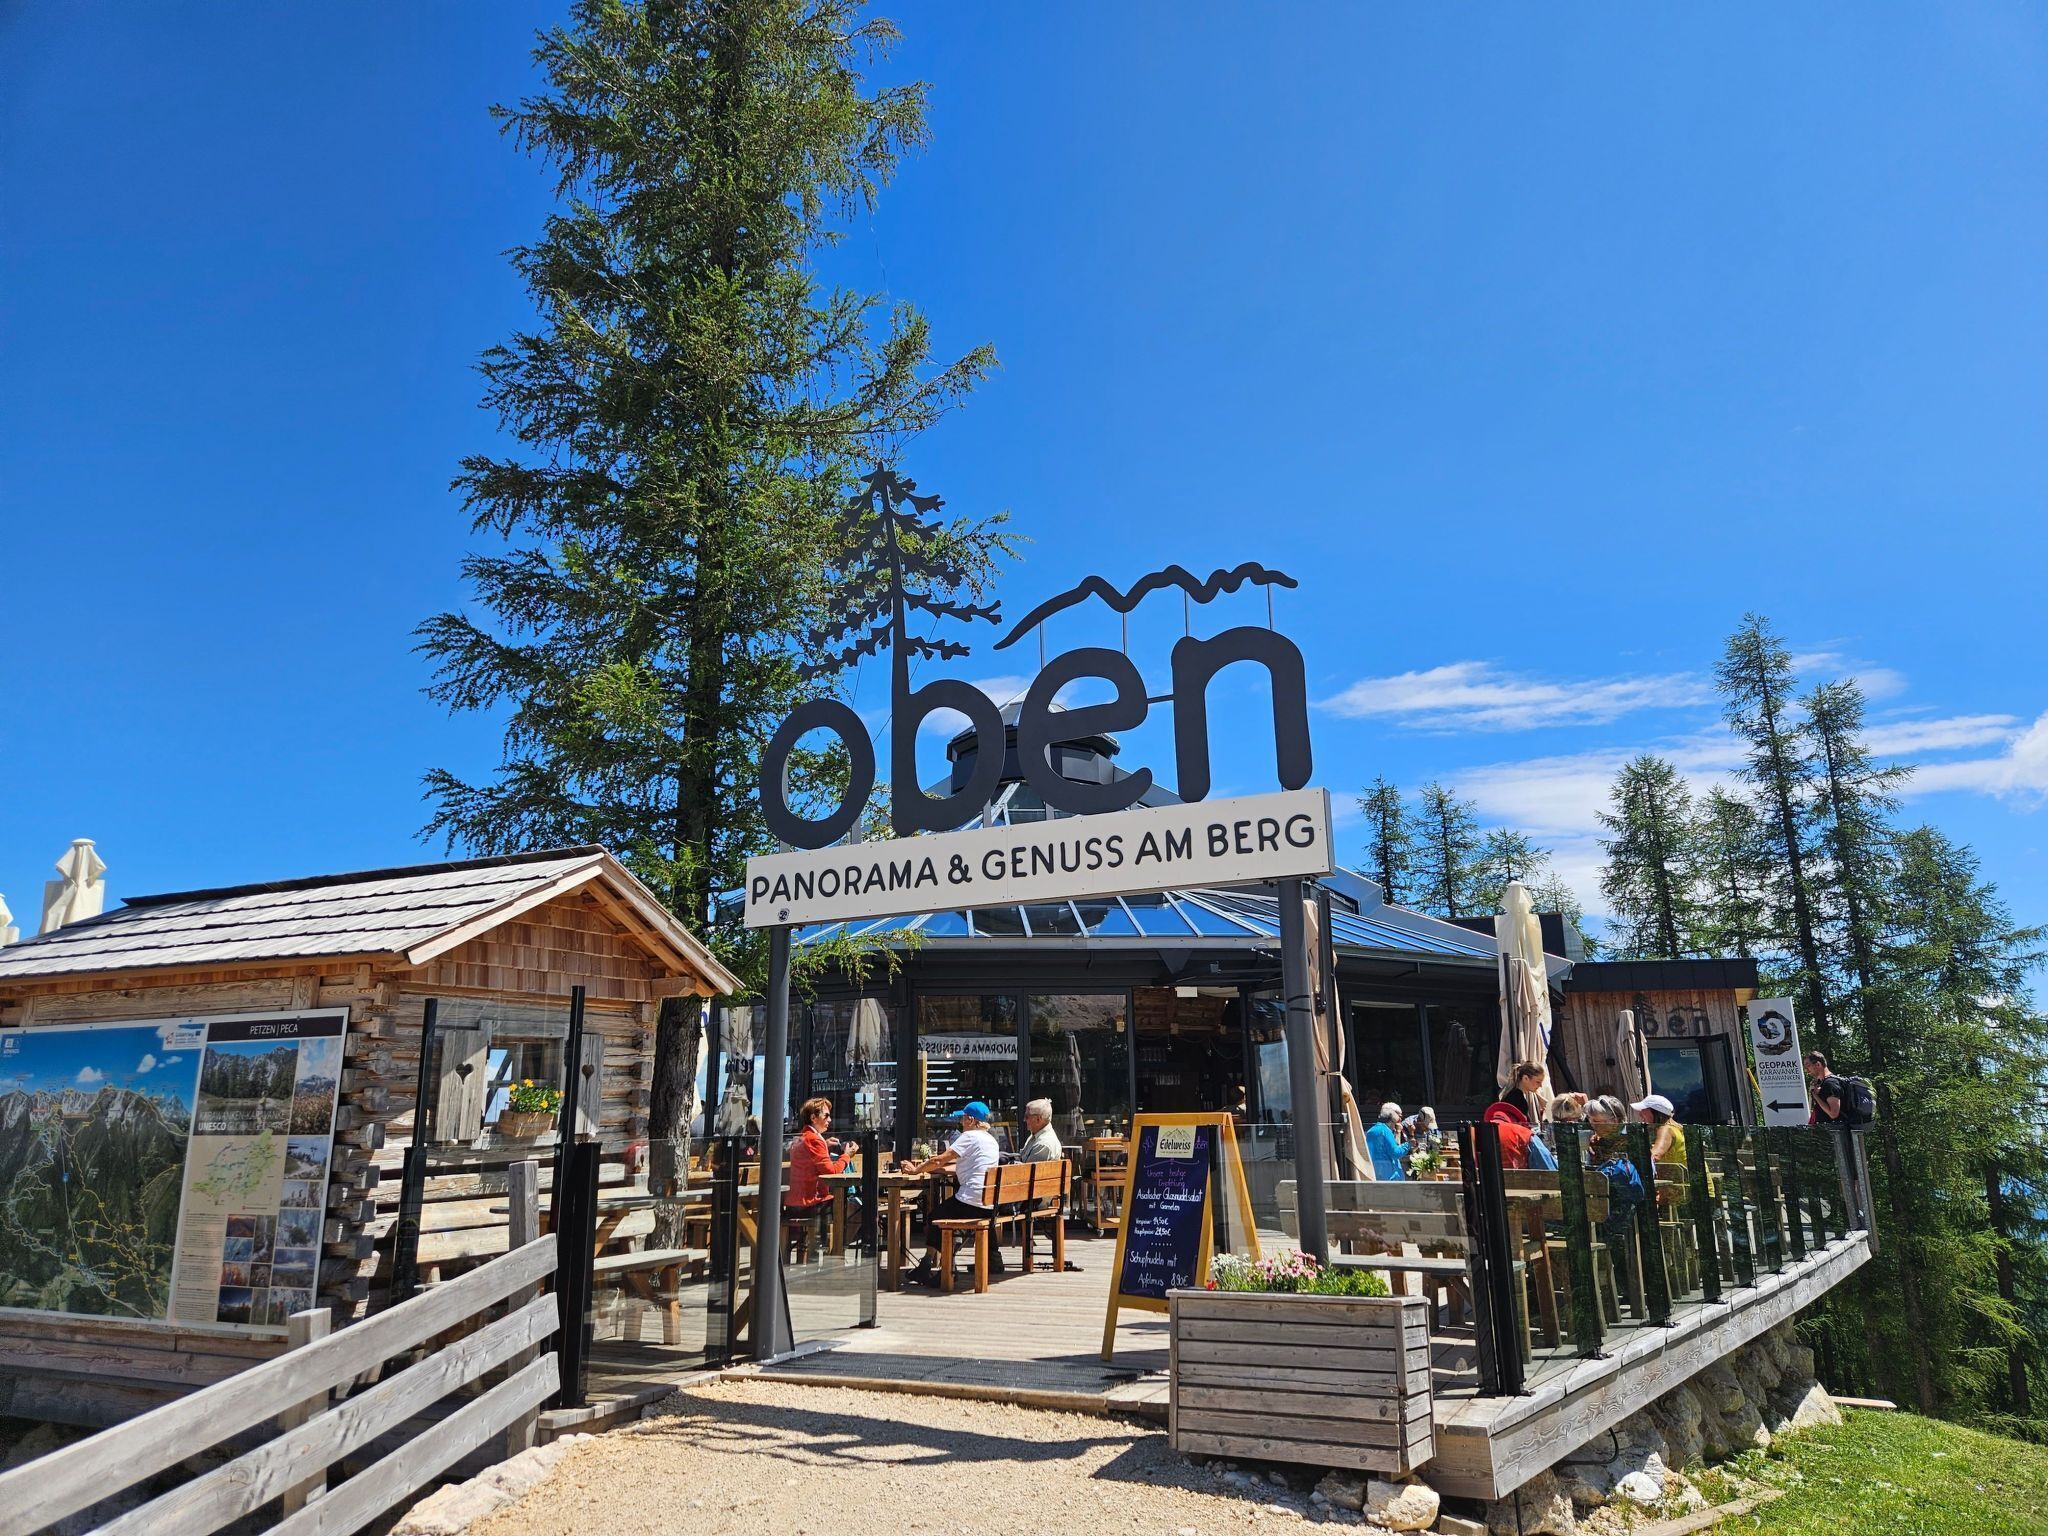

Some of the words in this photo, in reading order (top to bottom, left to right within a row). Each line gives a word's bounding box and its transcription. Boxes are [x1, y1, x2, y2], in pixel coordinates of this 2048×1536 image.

[760, 580, 1311, 850] oben
[751, 856, 938, 904] PANORAMA
[948, 853, 972, 885] &
[982, 834, 1123, 881] GENUSS
[1135, 828, 1193, 866] AM
[1208, 813, 1316, 858] BERG
[249, 1024, 277, 1035] PETZEN
[280, 1023, 299, 1034] PECA
[1758, 1060, 1798, 1070] GEOPARK
[1760, 1068, 1800, 1076] KARAVANKE
[198, 1122, 227, 1131] UNESCO
[1160, 1138, 1191, 1150] Edelweiss
[1129, 1250, 1164, 1268] Schupfnudeln
[1166, 1253, 1177, 1267] mit
[1138, 1272, 1164, 1288] Apfelmus
